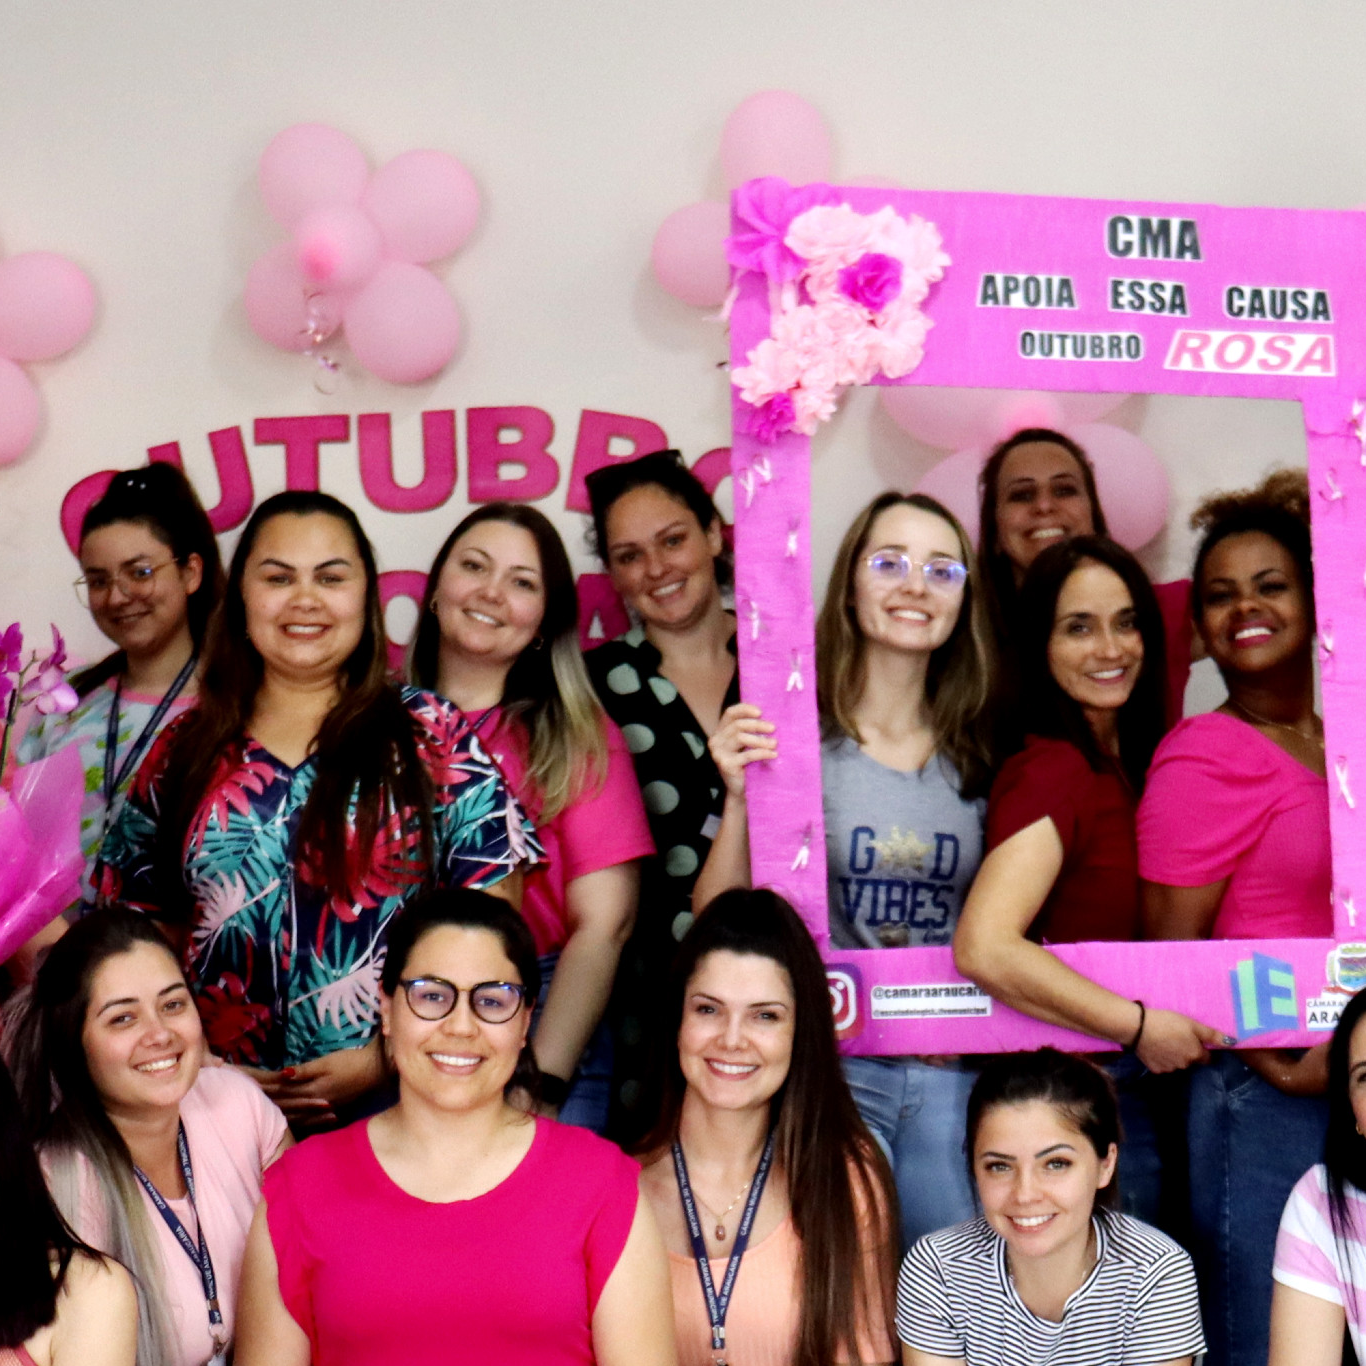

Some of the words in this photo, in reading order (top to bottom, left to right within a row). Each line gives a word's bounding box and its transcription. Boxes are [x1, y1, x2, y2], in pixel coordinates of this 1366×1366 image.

[1107, 215, 1202, 260] CMA
[980, 274, 1075, 308] APOIA
[1111, 279, 1188, 316] ESSA
[1226, 286, 1332, 321] CAUSA
[1020, 331, 1141, 360] OUTUBRO
[1167, 331, 1334, 373] ROSA
